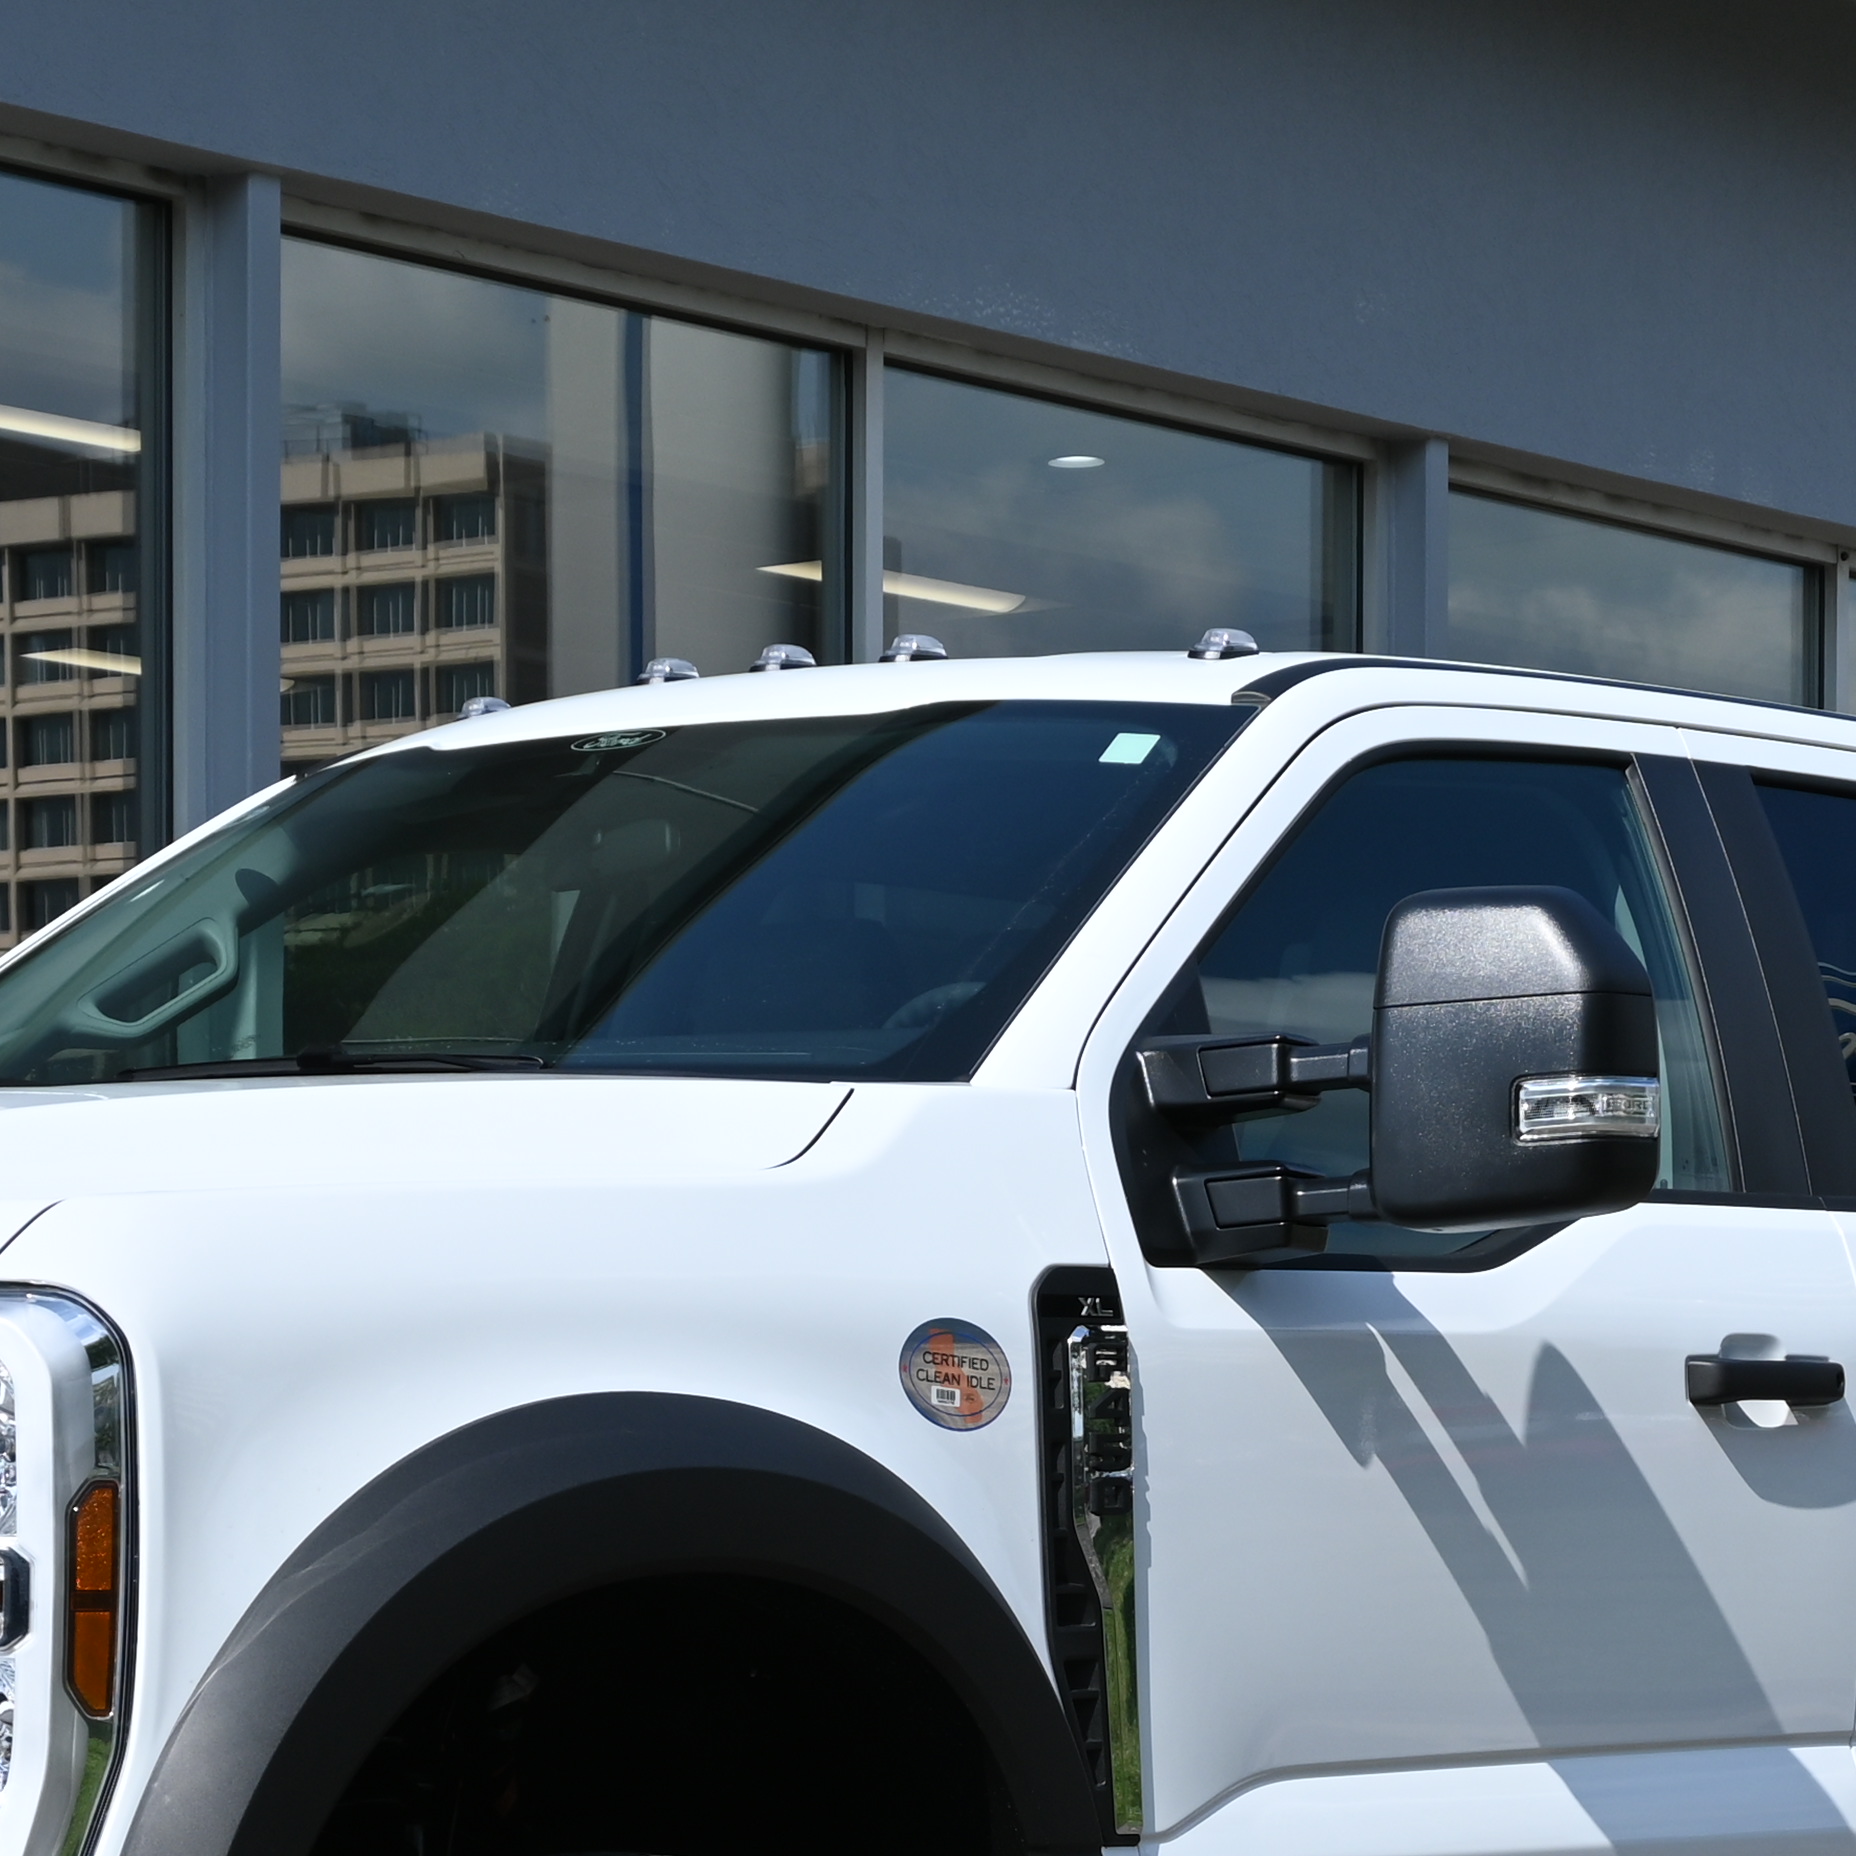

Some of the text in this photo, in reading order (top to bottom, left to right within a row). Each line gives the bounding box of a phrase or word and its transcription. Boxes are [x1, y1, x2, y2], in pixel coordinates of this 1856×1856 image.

[583, 731, 652, 749] Ford
[1078, 1297, 1113, 1316] XL
[923, 1351, 989, 1371] CERTIFIED
[916, 1368, 996, 1391] CLEAN IDLE
